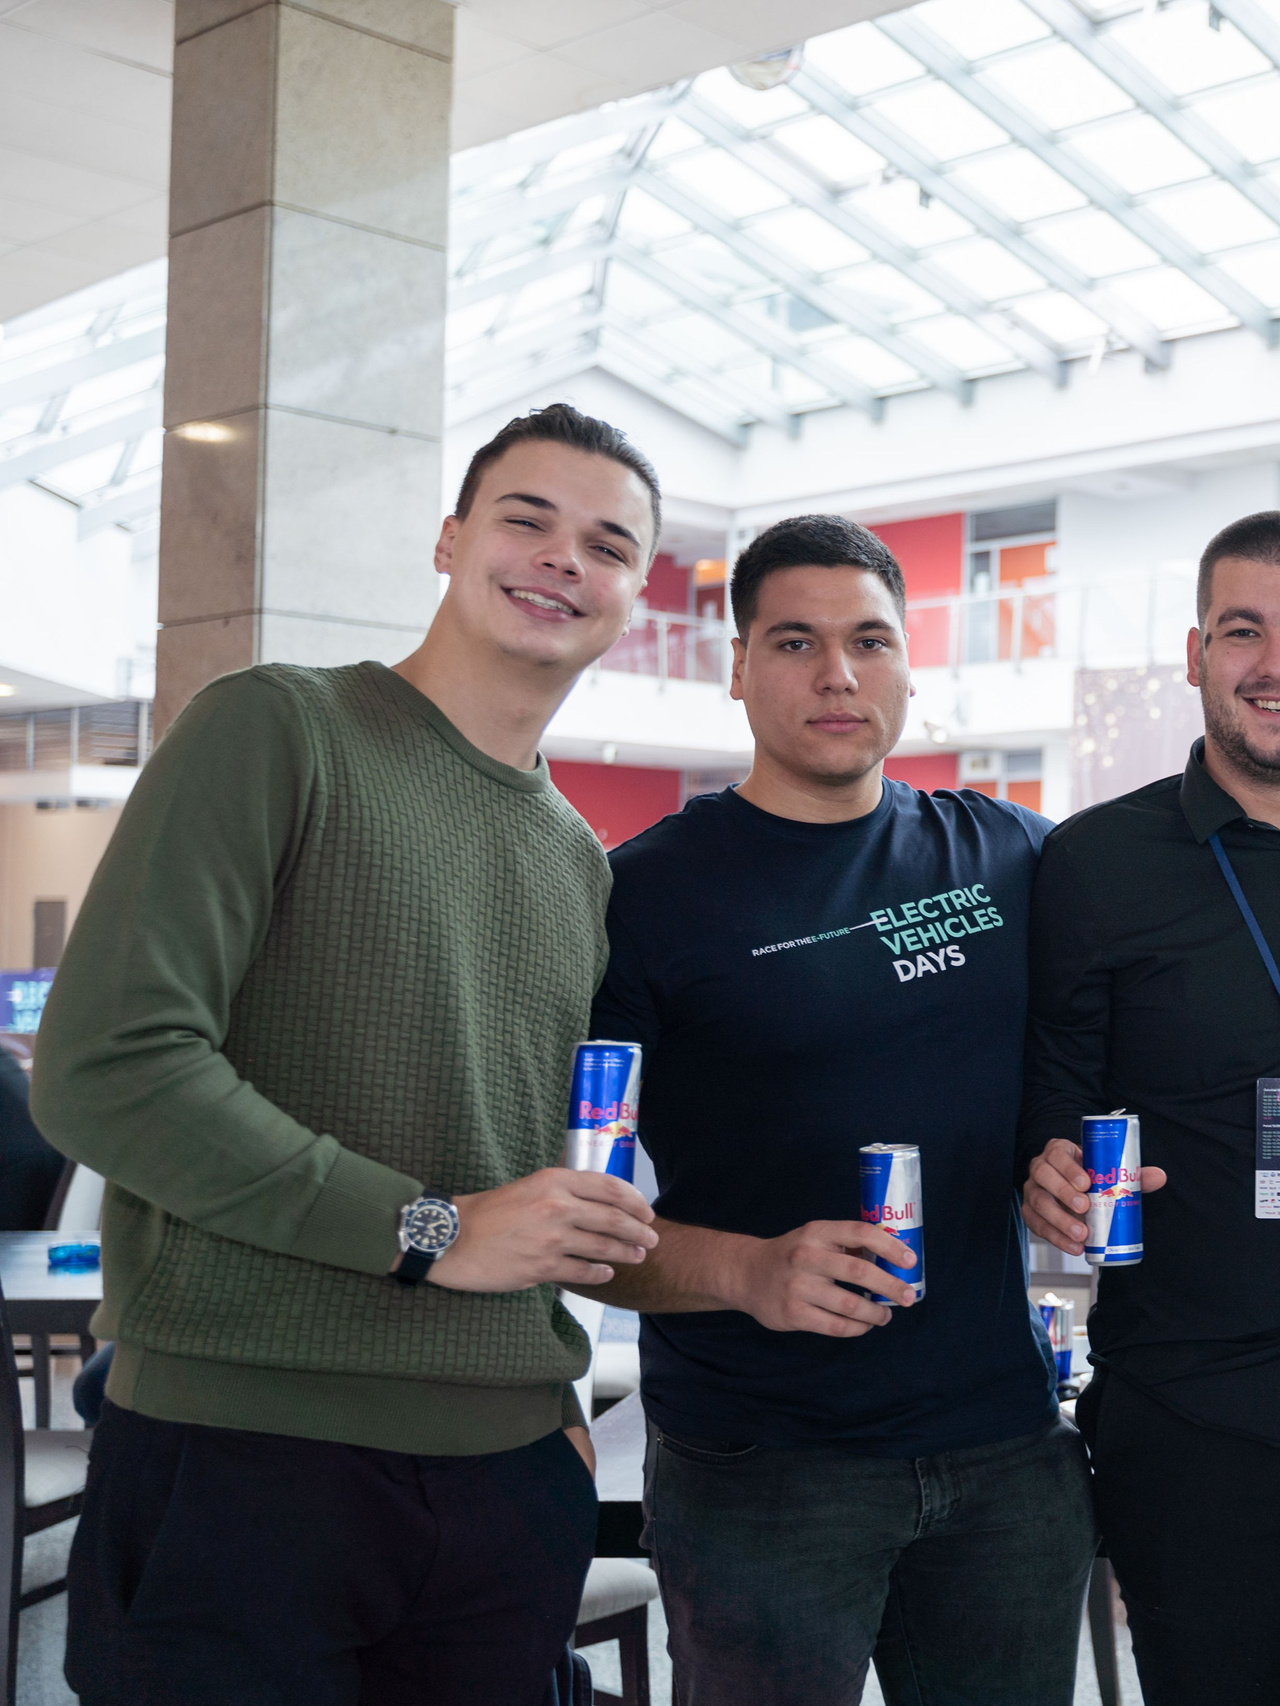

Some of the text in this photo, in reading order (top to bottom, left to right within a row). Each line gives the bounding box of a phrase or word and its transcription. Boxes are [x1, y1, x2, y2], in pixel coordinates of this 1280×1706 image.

[869, 883, 991, 932] ELECTRIC
[751, 944, 778, 957] RACE
[811, 927, 851, 943] E-FUTURE
[880, 906, 1004, 955] VEHICLES
[892, 945, 966, 983] DAYS
[579, 1101, 618, 1120] Red
[860, 1202, 913, 1221] ed Bull
